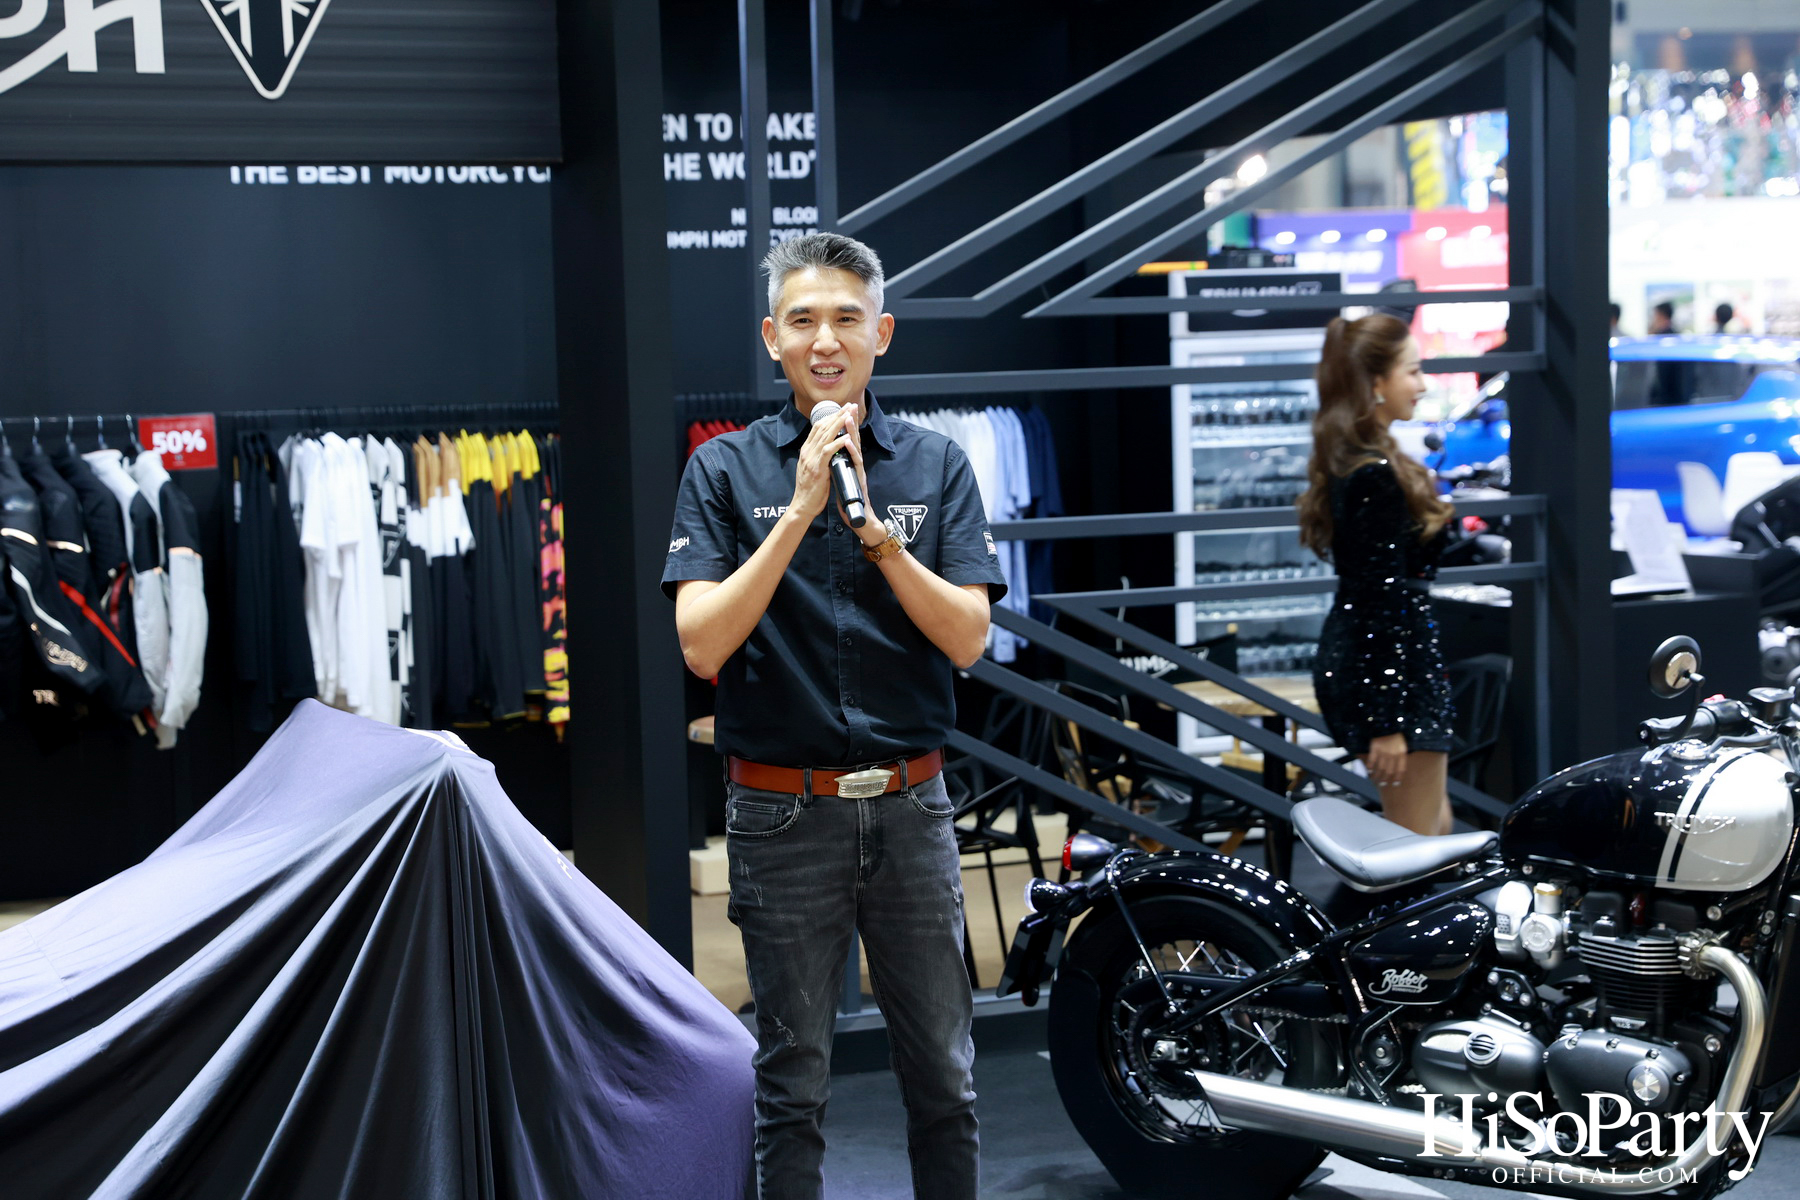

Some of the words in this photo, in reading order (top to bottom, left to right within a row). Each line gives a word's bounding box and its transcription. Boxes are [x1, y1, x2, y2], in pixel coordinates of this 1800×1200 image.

[693, 113, 733, 141] TO
[740, 112, 816, 140] AKE
[152, 428, 207, 455] 50%
[1369, 968, 1428, 995] Bobber
